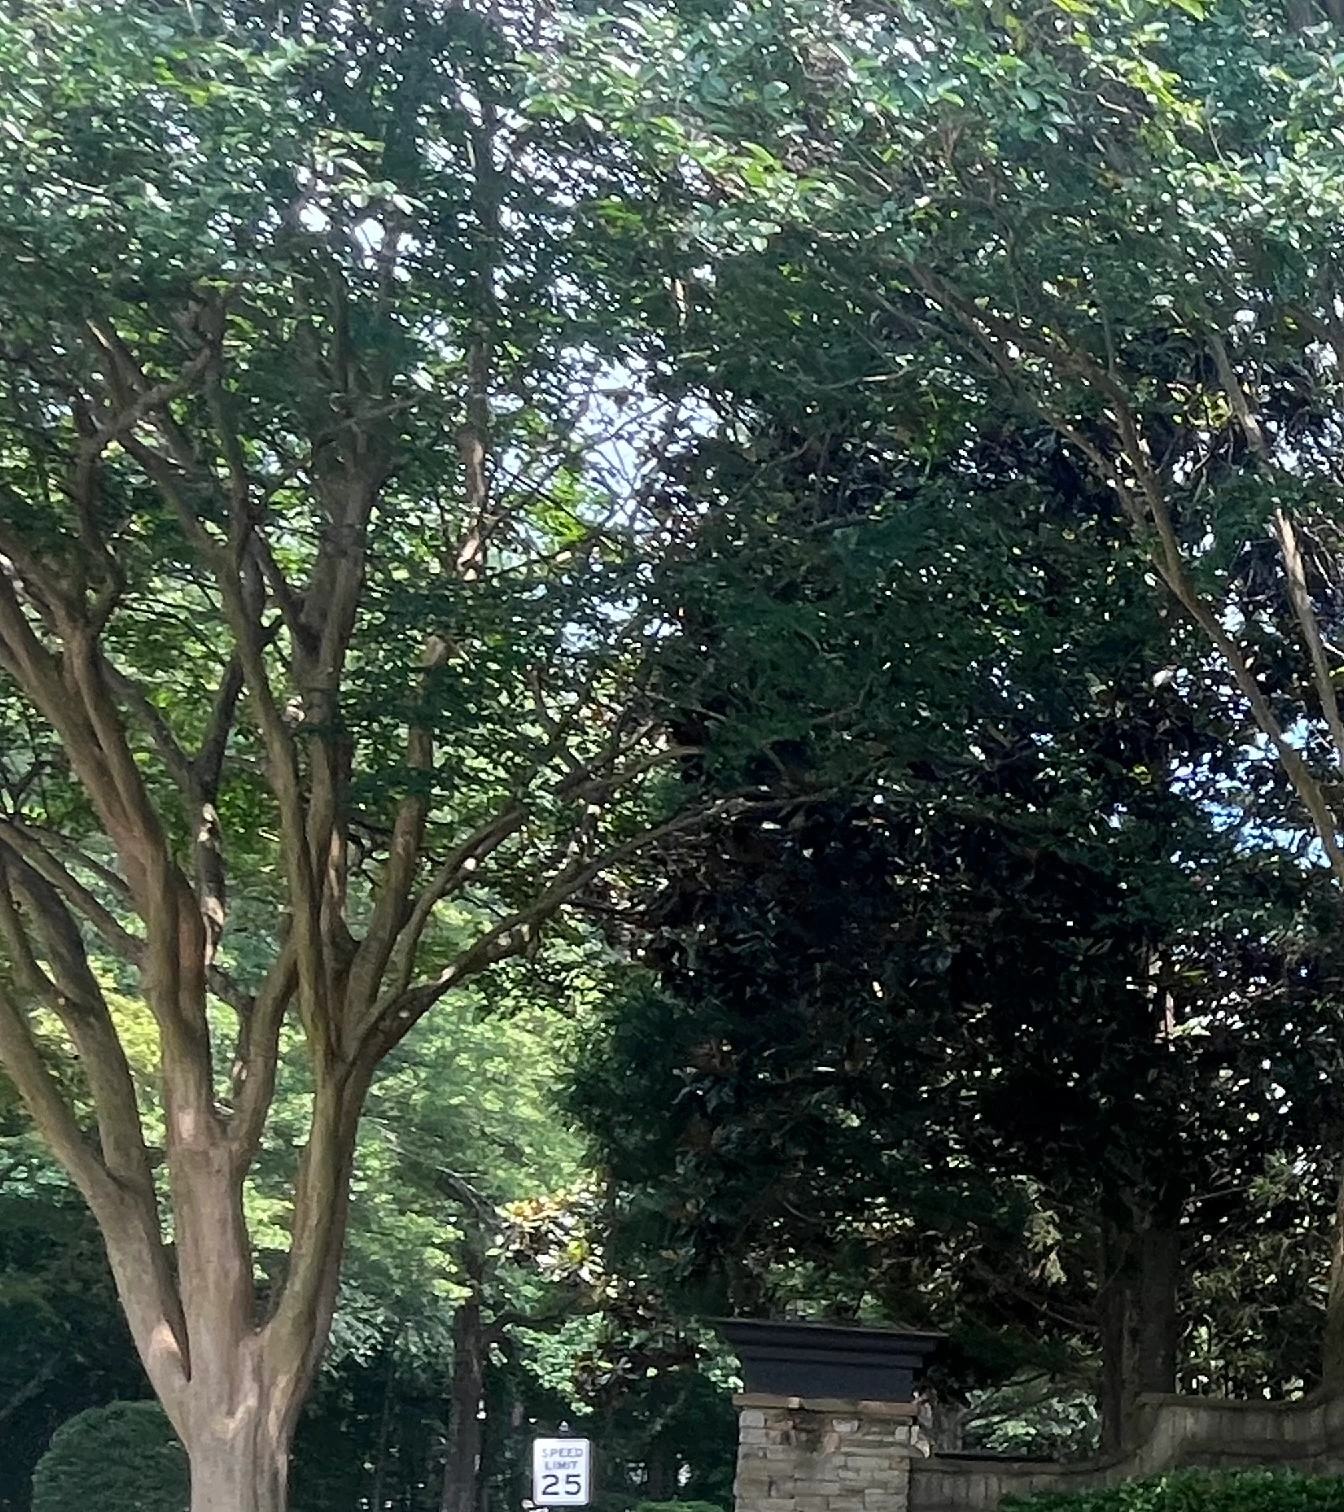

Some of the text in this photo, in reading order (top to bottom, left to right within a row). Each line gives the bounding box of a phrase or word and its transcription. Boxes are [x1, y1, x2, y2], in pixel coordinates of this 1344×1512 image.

[542, 1448, 583, 1457] SPEED
[544, 1461, 578, 1470] LIMIT
[542, 1474, 581, 1495] 25
